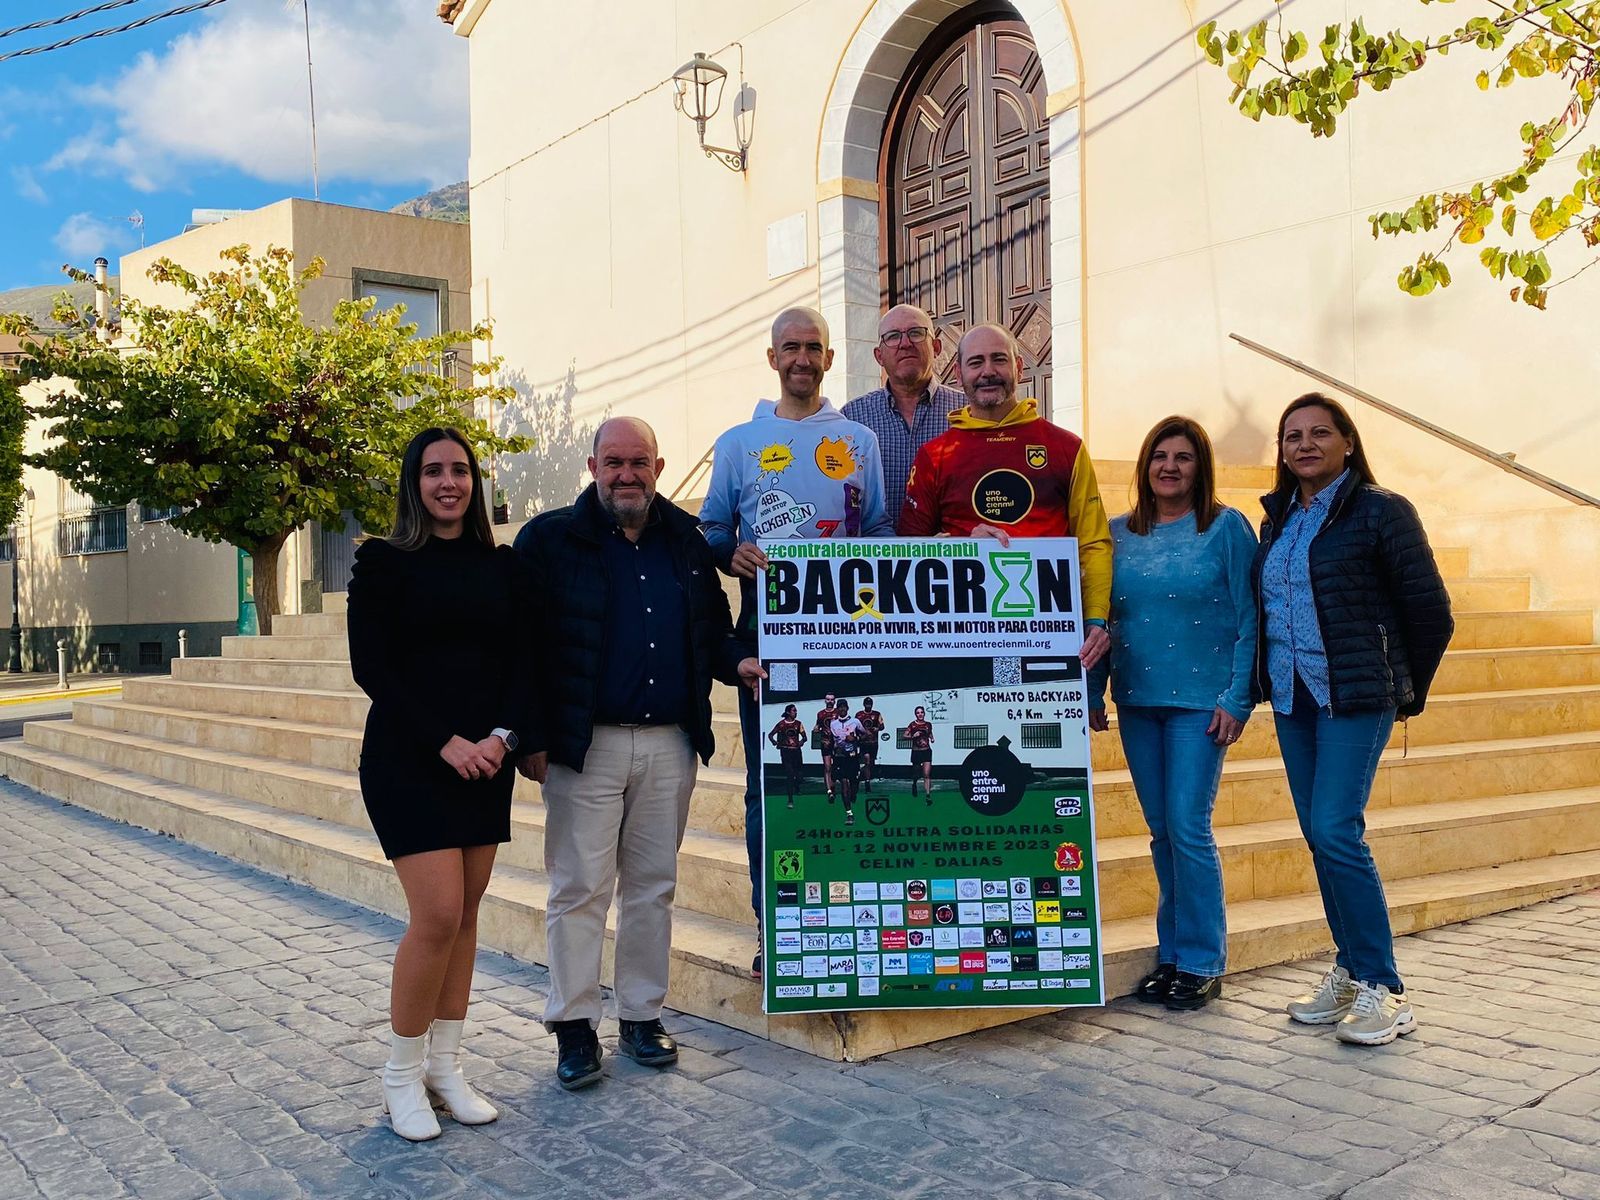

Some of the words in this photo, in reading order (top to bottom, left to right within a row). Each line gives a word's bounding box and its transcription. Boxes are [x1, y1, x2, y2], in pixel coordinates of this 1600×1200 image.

[761, 493, 780, 507] 48h
[772, 501, 788, 511] STOP
[986, 500, 1015, 508] cienmil
[765, 542, 979, 558] #contralaleucemiainfantil
[763, 622, 817, 635] VUESTRA
[819, 622, 855, 635] LUCHA
[858, 622, 882, 635] POR
[884, 621, 920, 636] VIVIR,
[920, 621, 935, 634] ES
[937, 621, 952, 633] MI
[955, 621, 995, 634] MOTOR
[997, 621, 1028, 633] PARA
[1030, 620, 1076, 633] CORRER
[802, 641, 869, 650] RECAUDACION
[870, 641, 877, 650] A
[879, 641, 909, 650] FAVOR
[910, 640, 923, 649] DE
[928, 639, 1051, 649] www.unoentrecienmil.org
[977, 691, 1025, 703] FORMATO
[1028, 690, 1082, 702] BACKYARD
[1007, 708, 1023, 720] 6,4
[1025, 708, 1043, 719] Km
[1054, 708, 1083, 719] +250
[972, 777, 998, 785] entre
[972, 784, 1006, 793] cienmil
[970, 794, 990, 804] .org
[796, 828, 875, 839] 24Horas
[883, 826, 941, 838] ULTRA
[947, 824, 1065, 836] SOLIDARIAS
[811, 844, 833, 855] 11
[853, 843, 876, 854] 12
[883, 841, 997, 854] NOVIEMBRE
[1004, 840, 1050, 851] 2023
[859, 857, 915, 869] CELIN
[935, 856, 1004, 867] DALIAS
